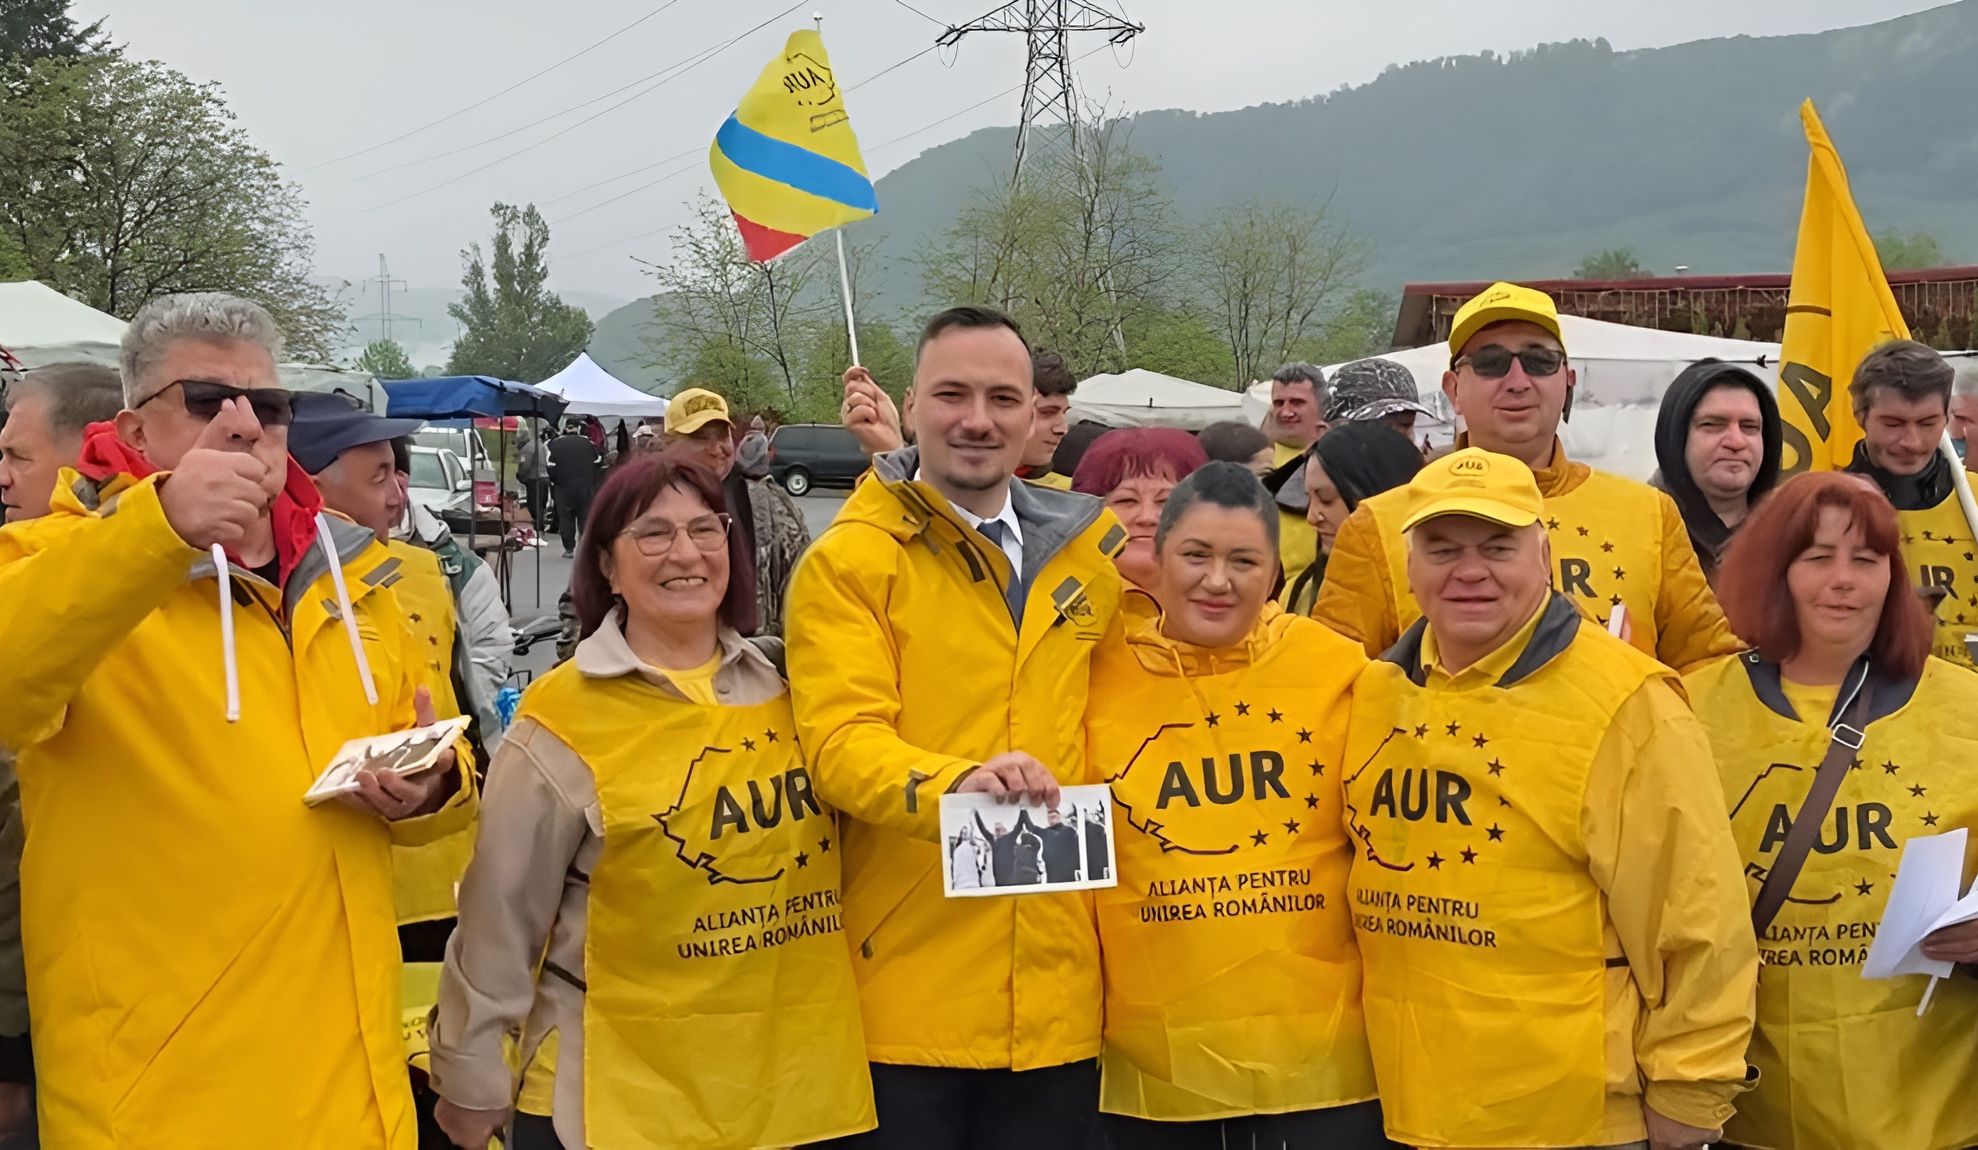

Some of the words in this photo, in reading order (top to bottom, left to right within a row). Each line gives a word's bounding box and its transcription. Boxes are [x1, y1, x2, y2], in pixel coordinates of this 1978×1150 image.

[1156, 751, 1291, 809] AUR
[710, 767, 822, 840] AUR
[1370, 768, 1472, 826] AUR
[1759, 802, 1898, 855] AUR
[1238, 869, 1311, 890] PENTRU
[1141, 904, 1206, 922] UNIREA
[1214, 893, 1325, 918] ROMÂNILOR
[1407, 894, 1479, 919] PENTRU
[677, 934, 757, 959] UNIREA
[1387, 918, 1496, 948] ROMÂNILOR
[1810, 944, 1869, 966] ROMÂ
